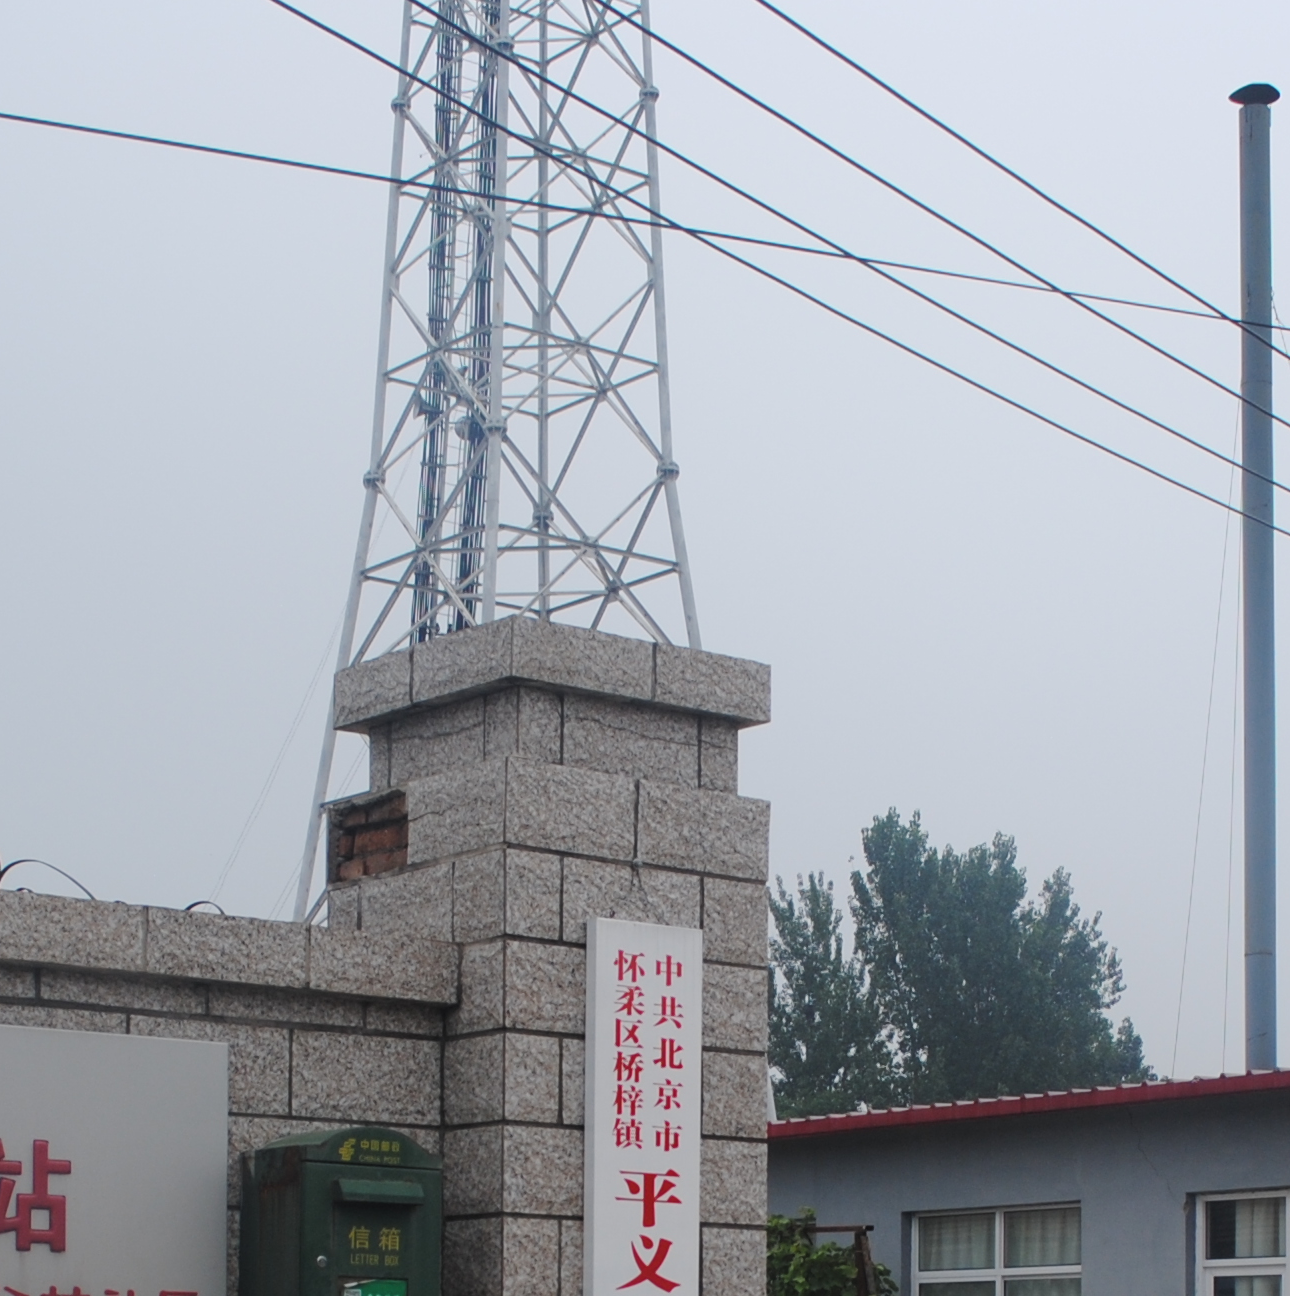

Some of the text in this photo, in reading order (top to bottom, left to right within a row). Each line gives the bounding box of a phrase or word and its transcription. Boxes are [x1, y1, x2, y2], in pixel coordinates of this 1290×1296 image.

[612, 948, 646, 1151] 怀柔区桥梓镇
[651, 954, 685, 1153] 中共北京市
[348, 1225, 401, 1251] 信箱
[350, 1253, 379, 1266] LETTER
